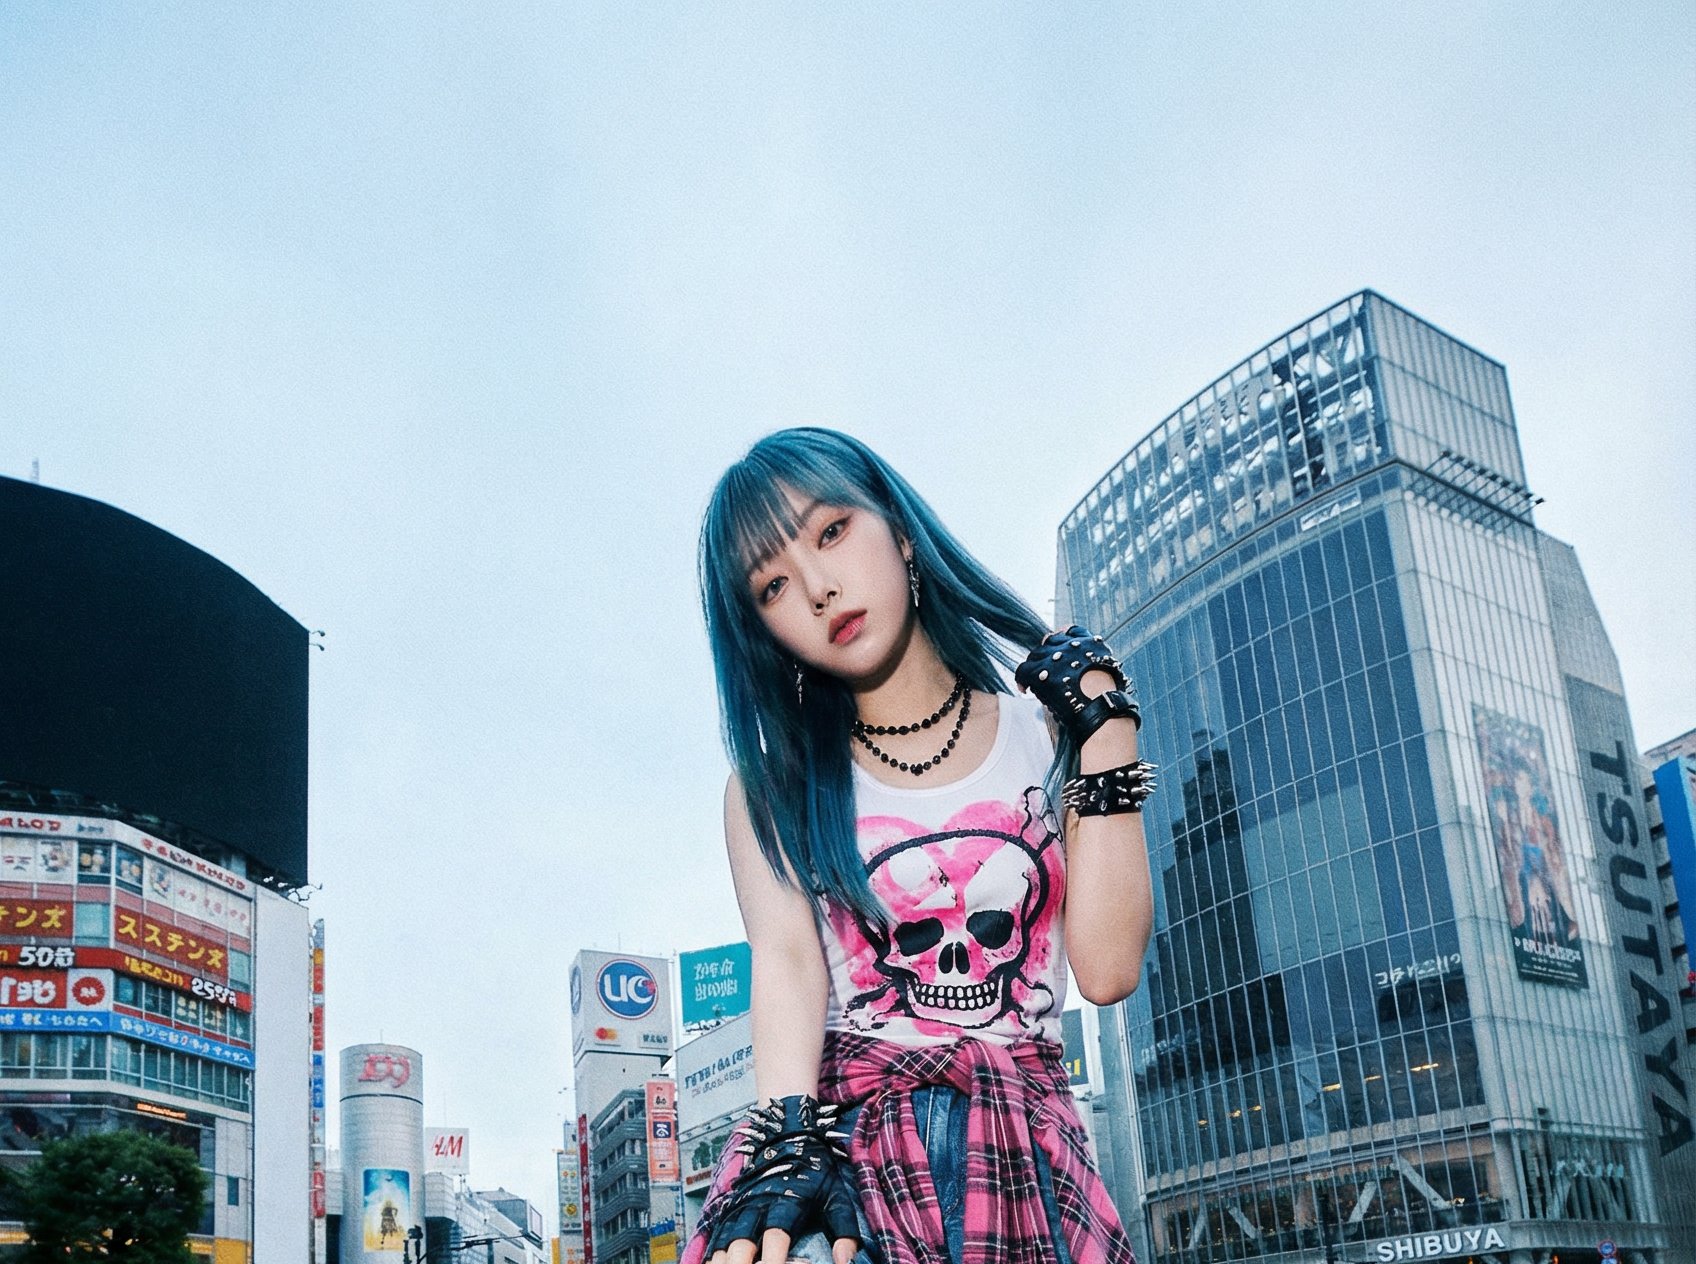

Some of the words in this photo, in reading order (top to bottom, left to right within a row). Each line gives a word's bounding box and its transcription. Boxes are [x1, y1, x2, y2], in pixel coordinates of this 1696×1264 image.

[1590, 740, 1695, 1157] TSUTAYA
[604, 973, 654, 1004] UC
[1377, 1227, 1505, 1263] SHIBUYA
